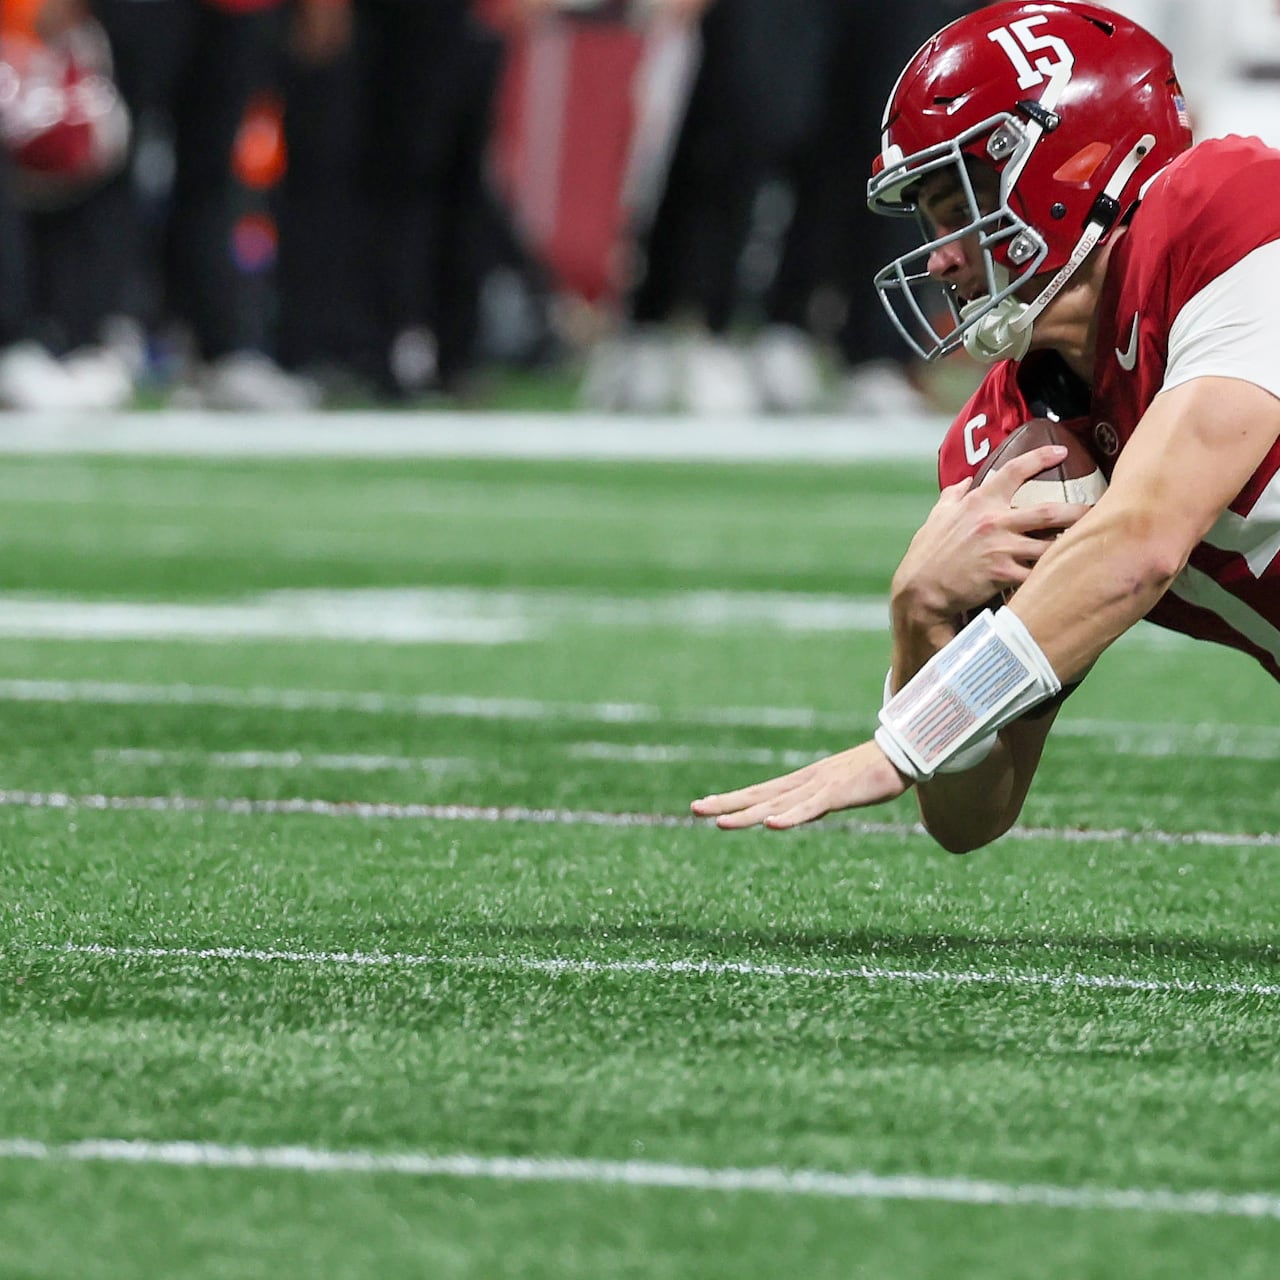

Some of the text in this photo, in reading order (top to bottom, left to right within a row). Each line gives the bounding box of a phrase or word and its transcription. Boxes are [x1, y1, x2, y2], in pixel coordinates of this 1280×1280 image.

[987, 15, 1074, 91] 15
[1037, 233, 1096, 306] CRIMSON TIDE
[963, 413, 991, 466] C
